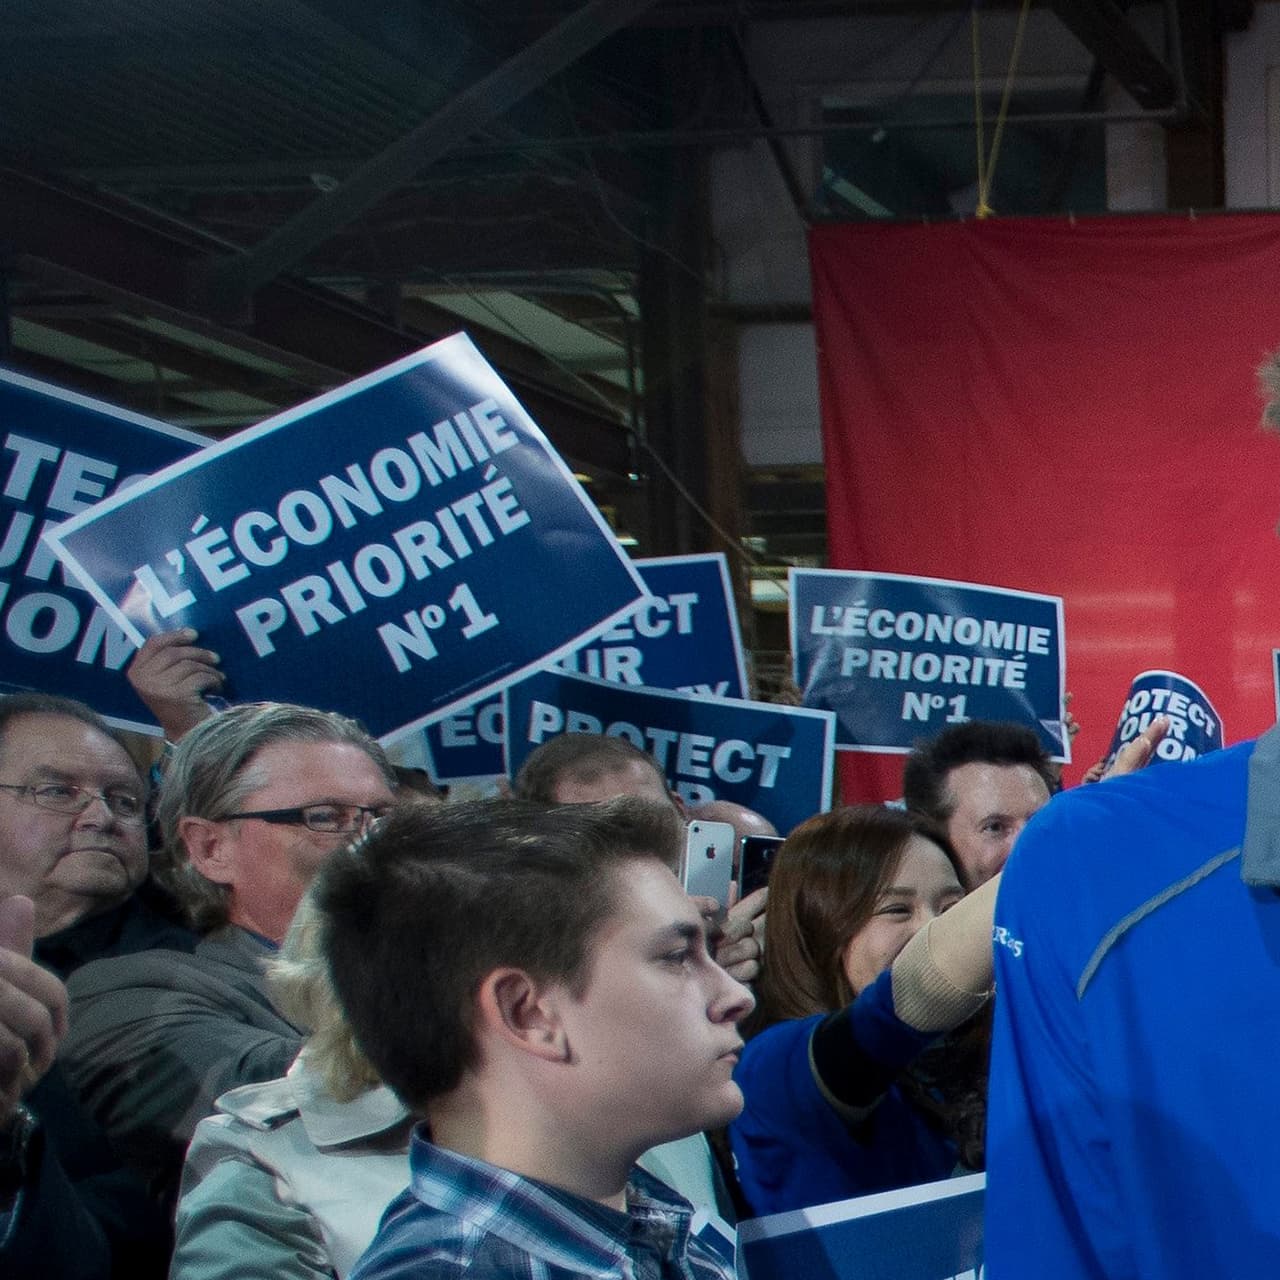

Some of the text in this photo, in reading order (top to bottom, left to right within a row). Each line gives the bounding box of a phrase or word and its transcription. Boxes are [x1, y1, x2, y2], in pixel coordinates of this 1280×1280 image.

[135, 399, 519, 617] L'ÉCONOMIE
[236, 465, 531, 657] PRIORITÉ
[810, 600, 1051, 656] L'ÉCONOMIE
[840, 647, 1028, 690] PRIORITÉ
